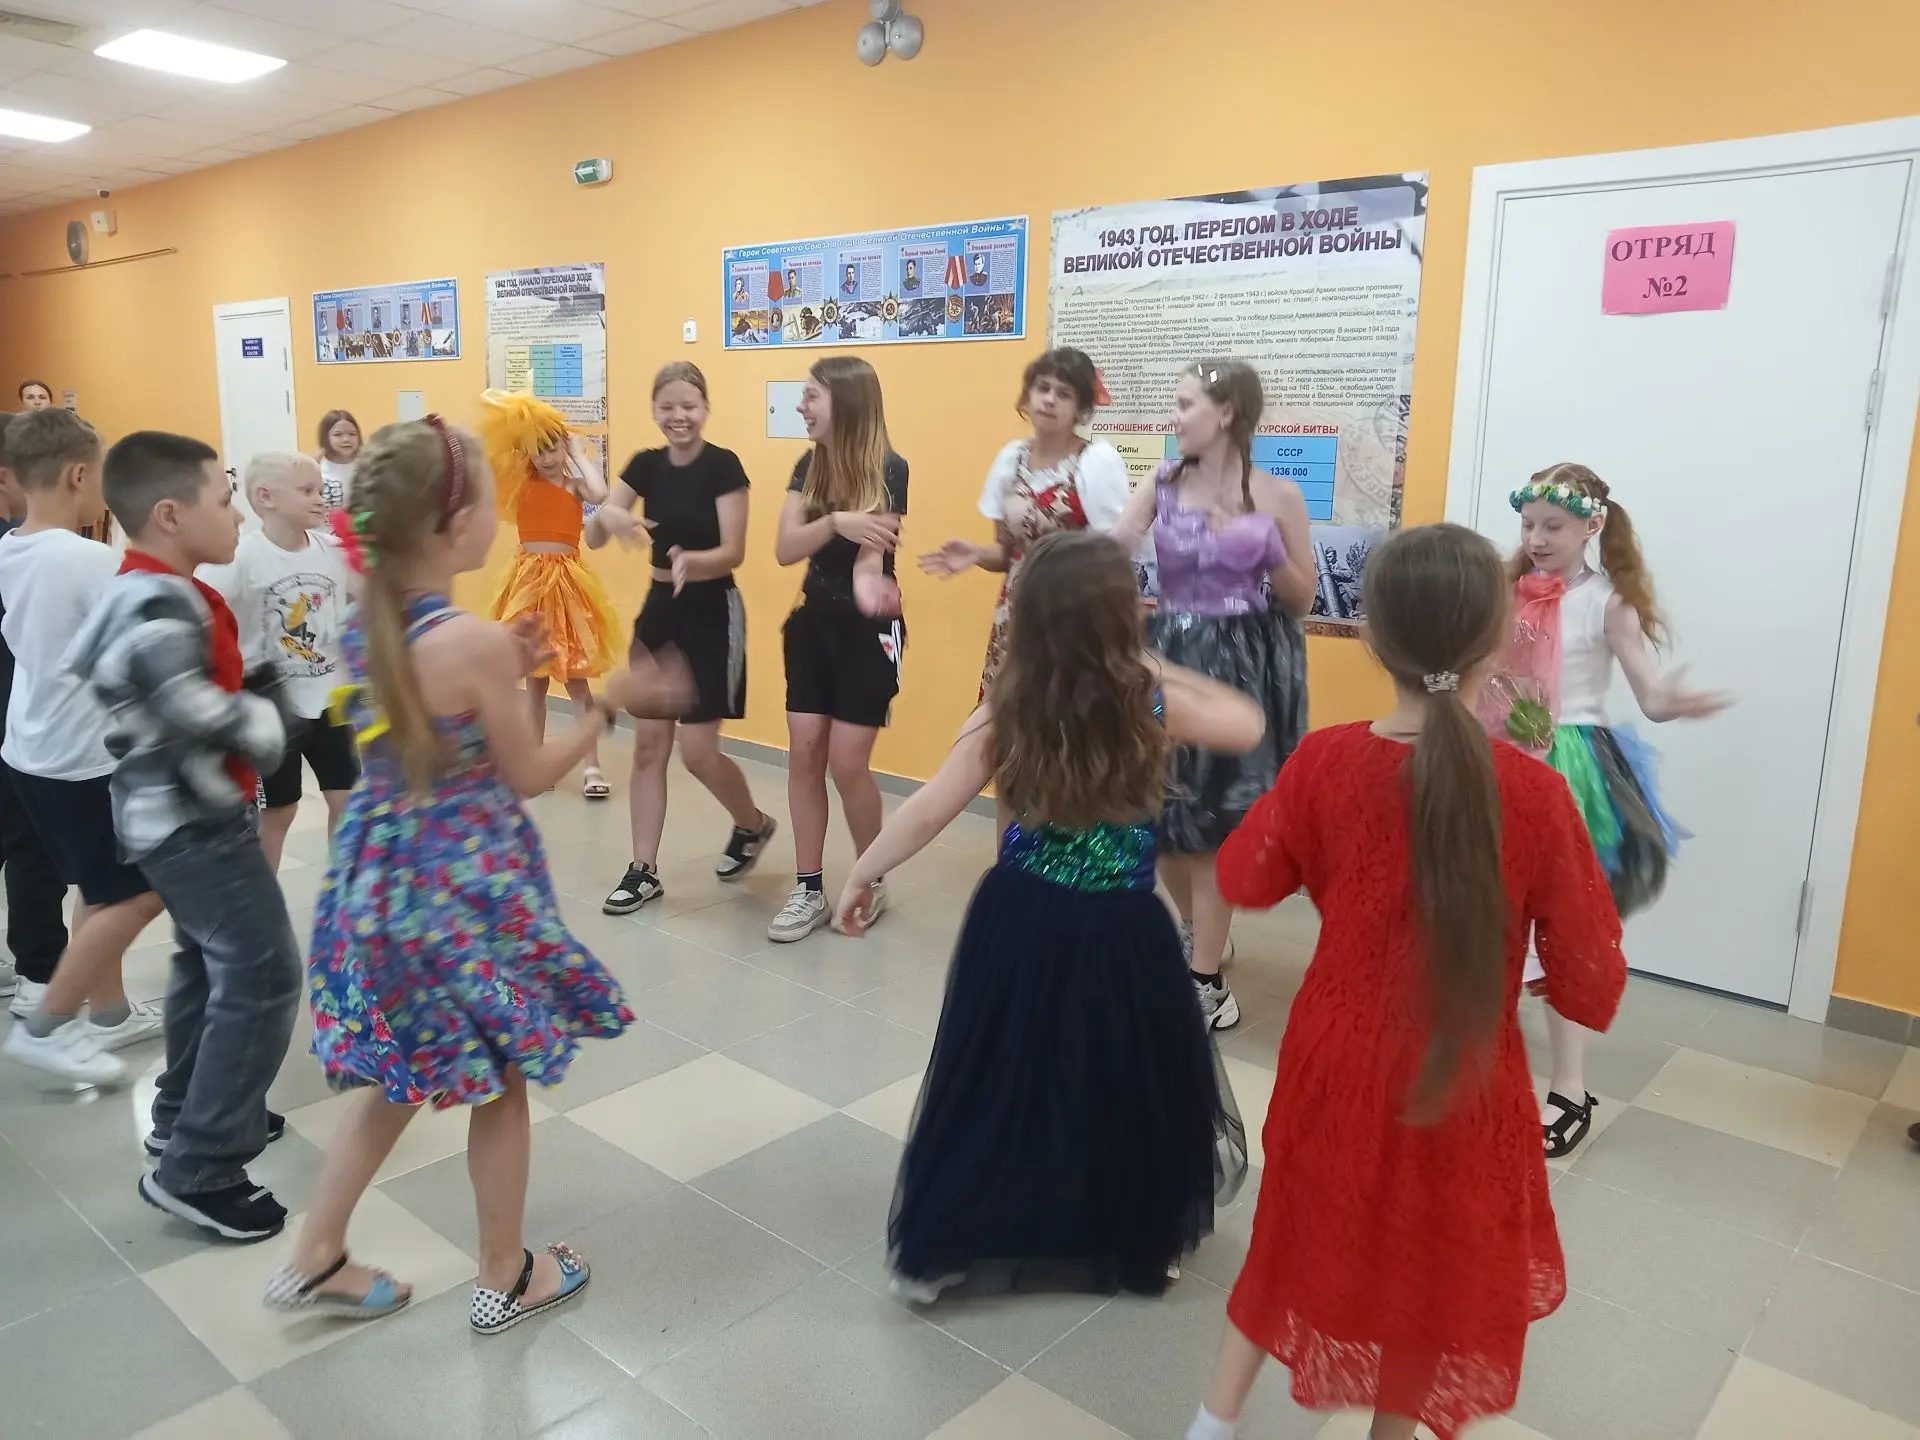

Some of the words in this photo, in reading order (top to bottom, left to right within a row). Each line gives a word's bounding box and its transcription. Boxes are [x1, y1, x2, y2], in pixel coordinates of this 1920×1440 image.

[1099, 229, 1134, 247] 1943
[1140, 224, 1178, 245] ГОД.
[1184, 215, 1276, 240] ПЕРЕЛОМ
[1281, 213, 1295, 232] В
[1299, 206, 1358, 231] ХОДЕ
[739, 249, 760, 258] Герои
[762, 244, 802, 255] Советского
[805, 242, 830, 250] Союза
[862, 234, 898, 245] Великой
[900, 226, 969, 240] Отечественной
[971, 224, 1005, 234] Войны
[1612, 232, 1716, 261] ОТРЯД
[1064, 246, 1143, 273] ВЕЛИКОЙ
[1148, 232, 1314, 267] ОТЕЧЕСТВЕННОЙ
[1319, 227, 1402, 254] ВОЙНЫ
[520, 277, 541, 286] НАЧАЛО
[576, 272, 592, 282] ХОДЕ
[496, 288, 520, 298] ВЕЛИКОЙ
[521, 285, 568, 297] ОТЕЧЕСТВЕННОЙ
[569, 283, 590, 293] ВОЙНЫ
[1642, 275, 1688, 299] №2
[1092, 423, 1153, 432] СООТНОШЕНИЕ
[1156, 424, 1173, 432] СИЛ
[1257, 423, 1300, 433] КУРСКОЙ
[1303, 425, 1338, 434] БИТВЫ
[1116, 445, 1138, 453] Силы
[1277, 448, 1303, 456] СССР
[1270, 467, 1290, 476] 1336
[1292, 468, 1308, 476] 000
